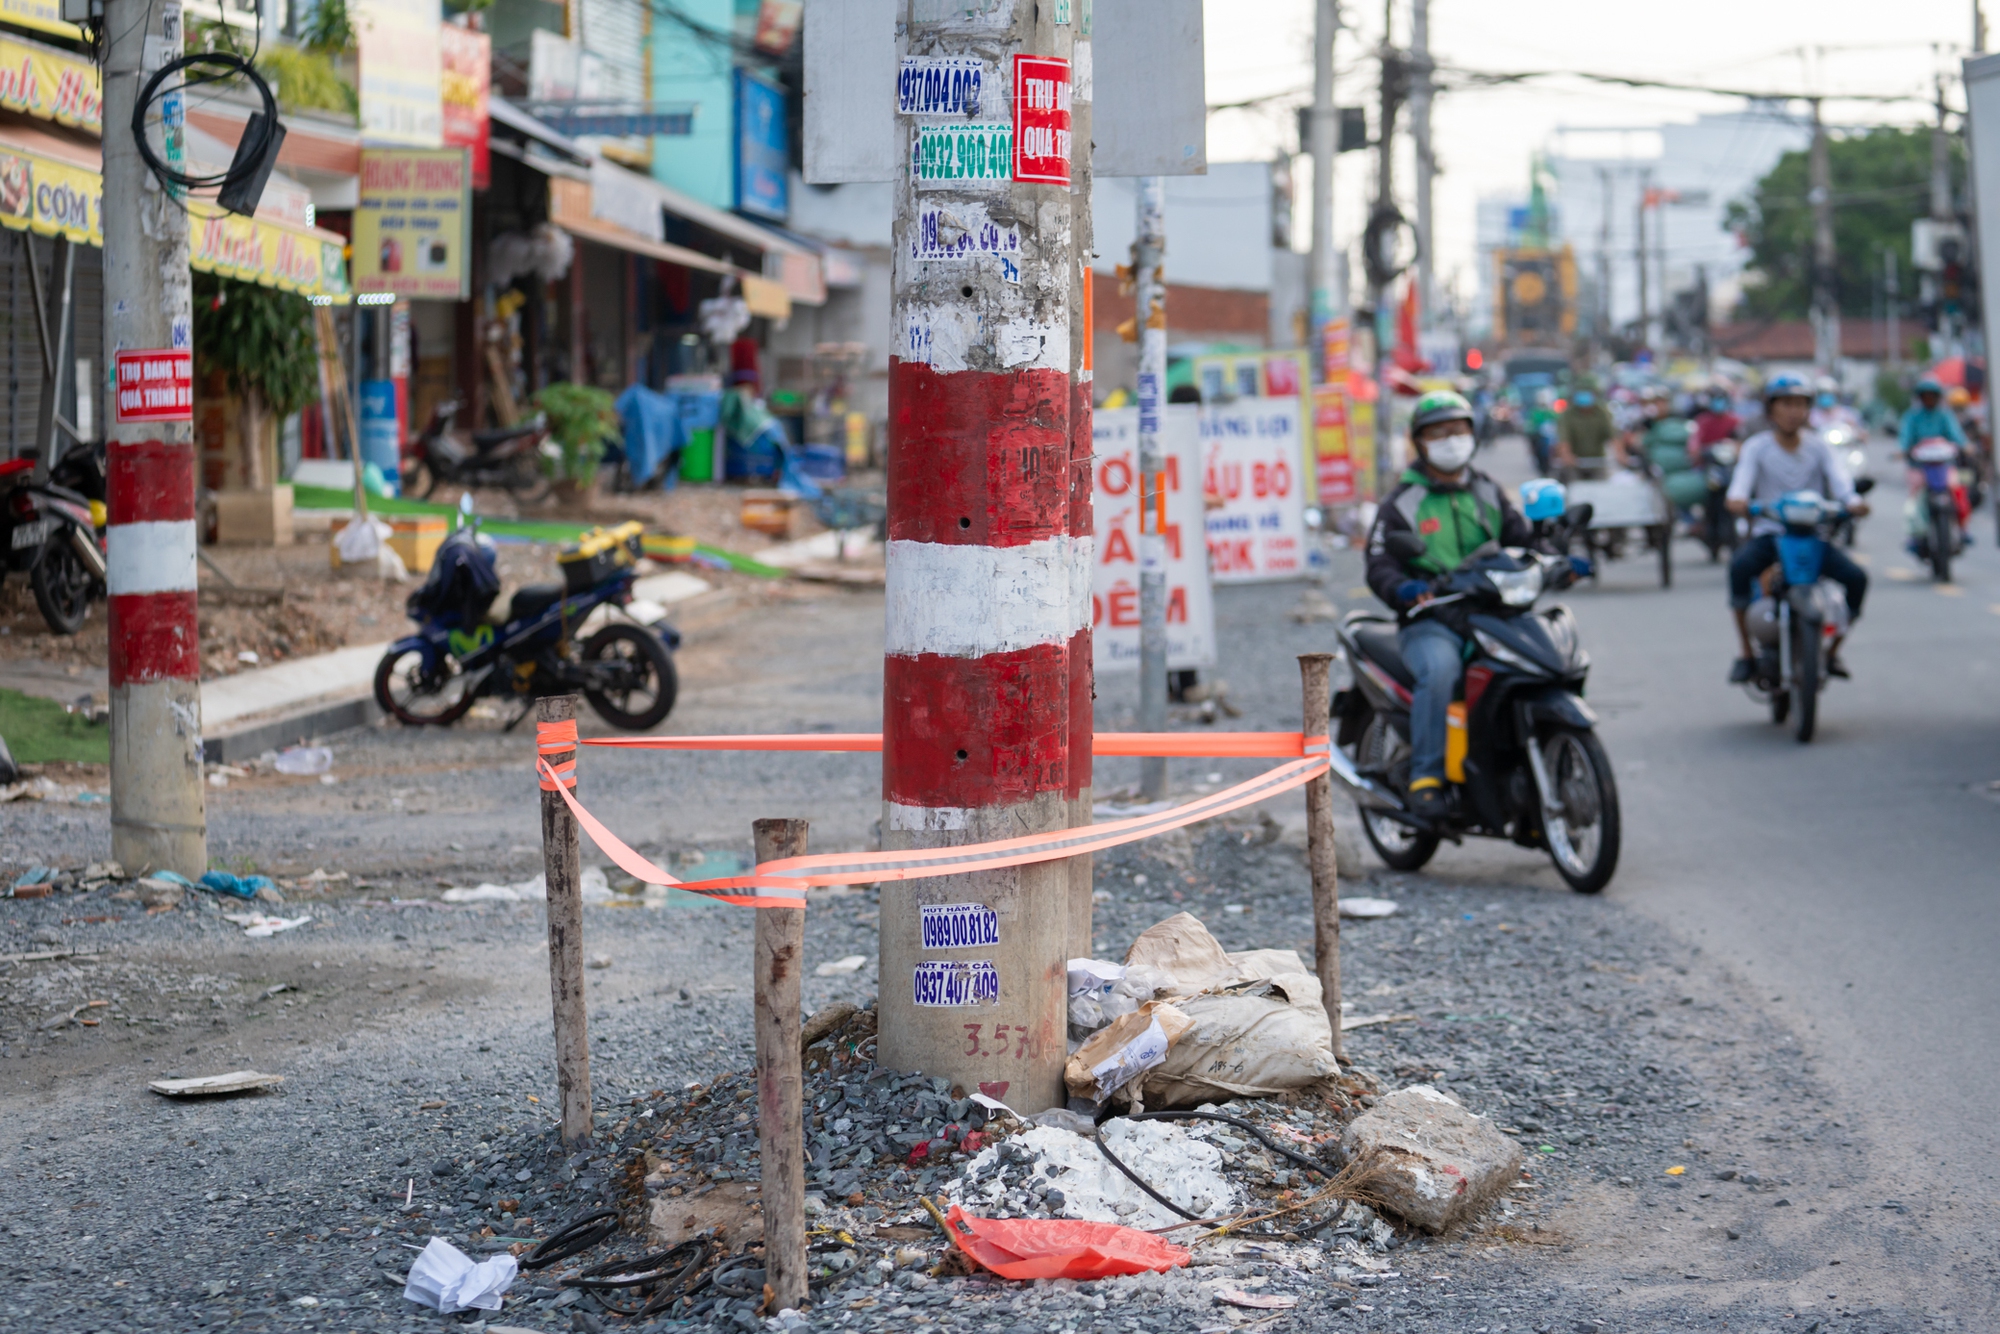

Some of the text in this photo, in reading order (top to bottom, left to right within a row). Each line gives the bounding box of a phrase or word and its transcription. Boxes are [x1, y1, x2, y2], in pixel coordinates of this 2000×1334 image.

[1026, 78, 1054, 115] TRỤ
[1024, 124, 1053, 160] QUÁ
[36, 178, 90, 230] CƠM
[121, 362, 141, 384] TRỤ
[143, 360, 173, 381] ĐANG
[923, 911, 998, 948] 0989.00.81.82
[914, 970, 998, 1005] 0937.407.409
